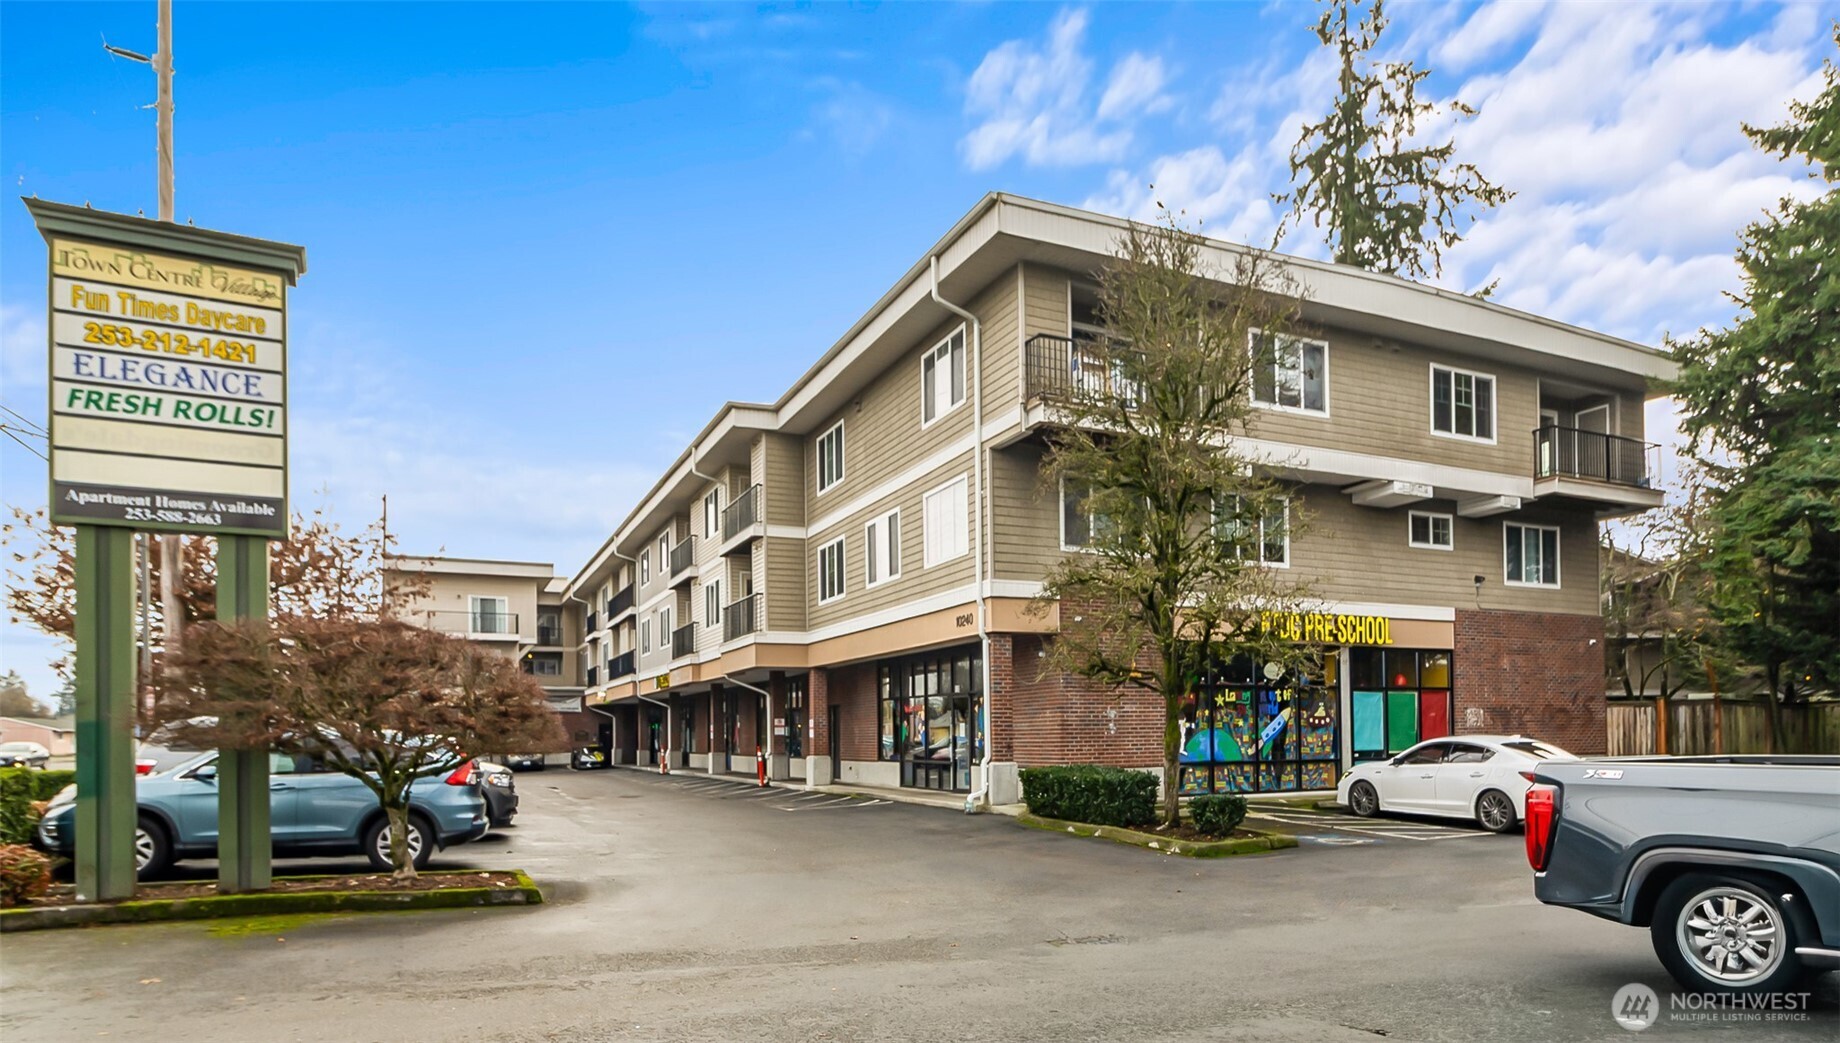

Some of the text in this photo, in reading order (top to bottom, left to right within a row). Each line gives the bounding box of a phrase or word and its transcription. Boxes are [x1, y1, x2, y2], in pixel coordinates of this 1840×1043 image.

[129, 261, 203, 288] CENTRE
[71, 284, 266, 334] Fun Times Daycare
[83, 322, 256, 364] 253-212-1421
[73, 352, 263, 397] ELEGANCE
[67, 388, 275, 428] FRESH ROLLS!
[65, 489, 275, 516] Apartment Homes Available
[125, 507, 222, 525] 253-588-2663
[956, 612, 974, 627] 10240
